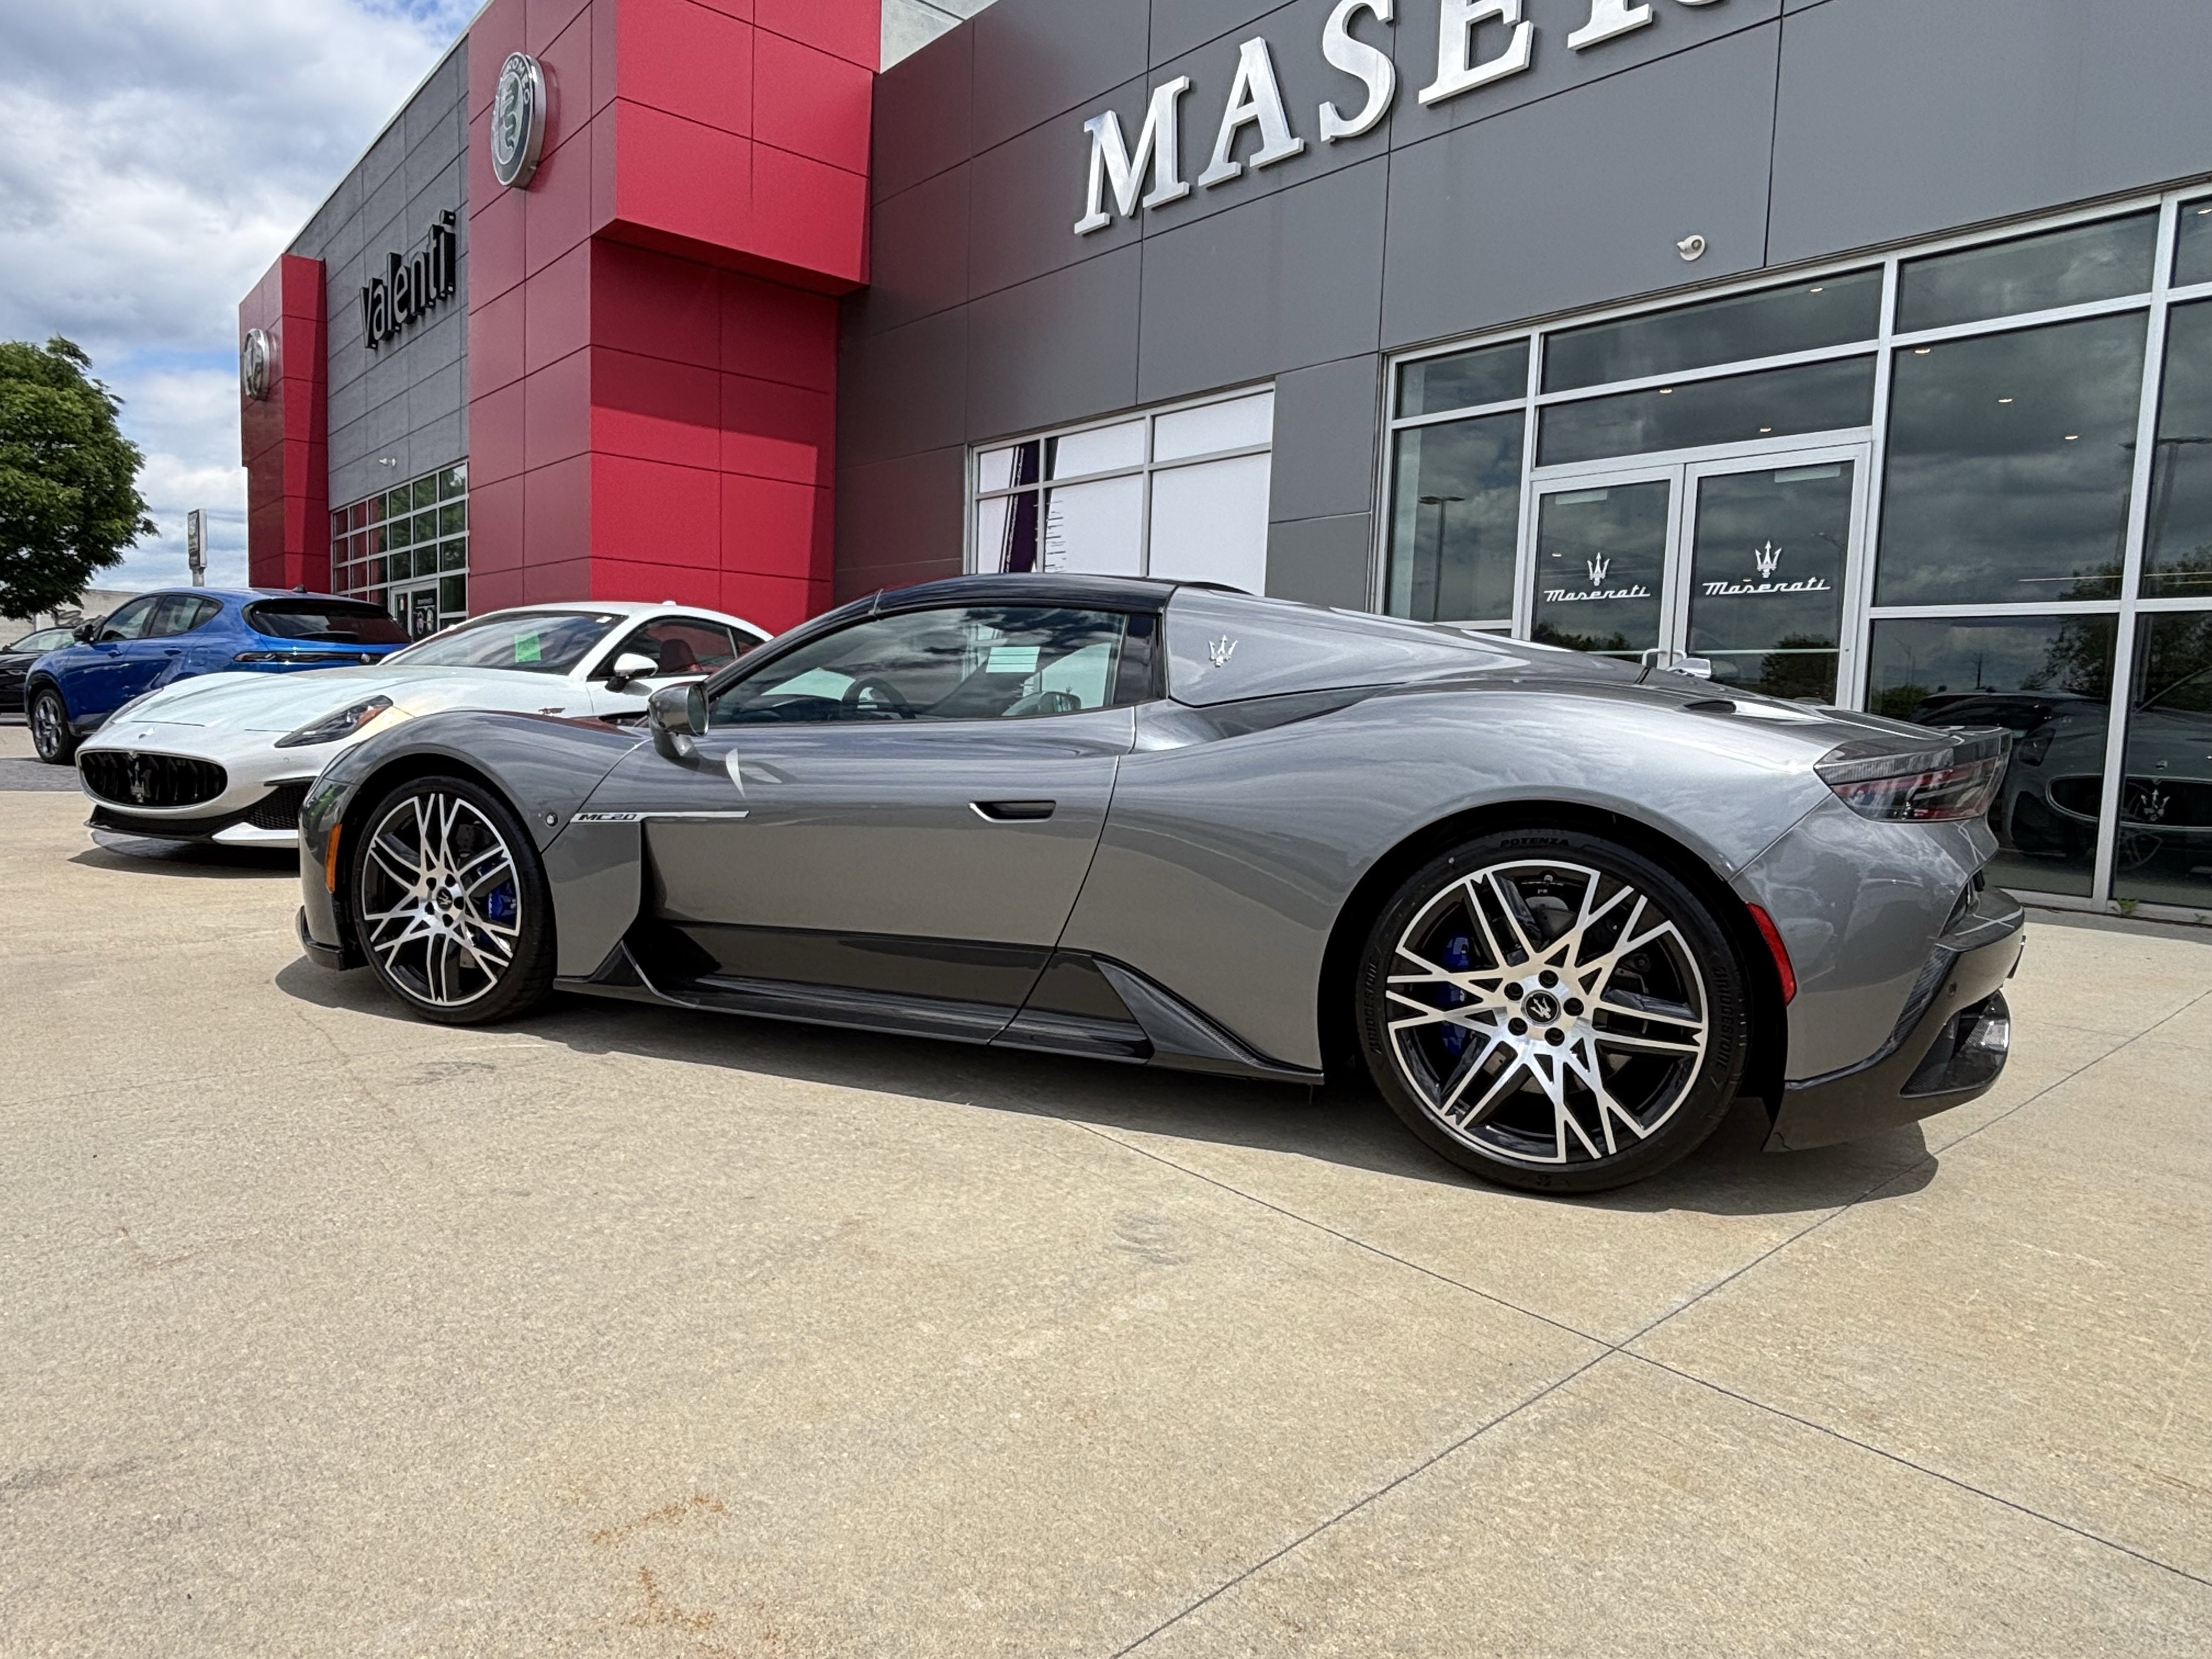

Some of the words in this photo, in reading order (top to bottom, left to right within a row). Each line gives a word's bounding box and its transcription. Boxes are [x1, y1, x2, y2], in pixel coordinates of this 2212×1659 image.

[1543, 585, 1651, 602] Maserati
[1702, 577, 1831, 596] Maserati
[578, 813, 638, 821] MC20
[1500, 837, 1570, 848] POTENZA
[1364, 957, 1382, 1056] BRIDGESTONE
[1712, 966, 1735, 1072] BRIDGESTONE
